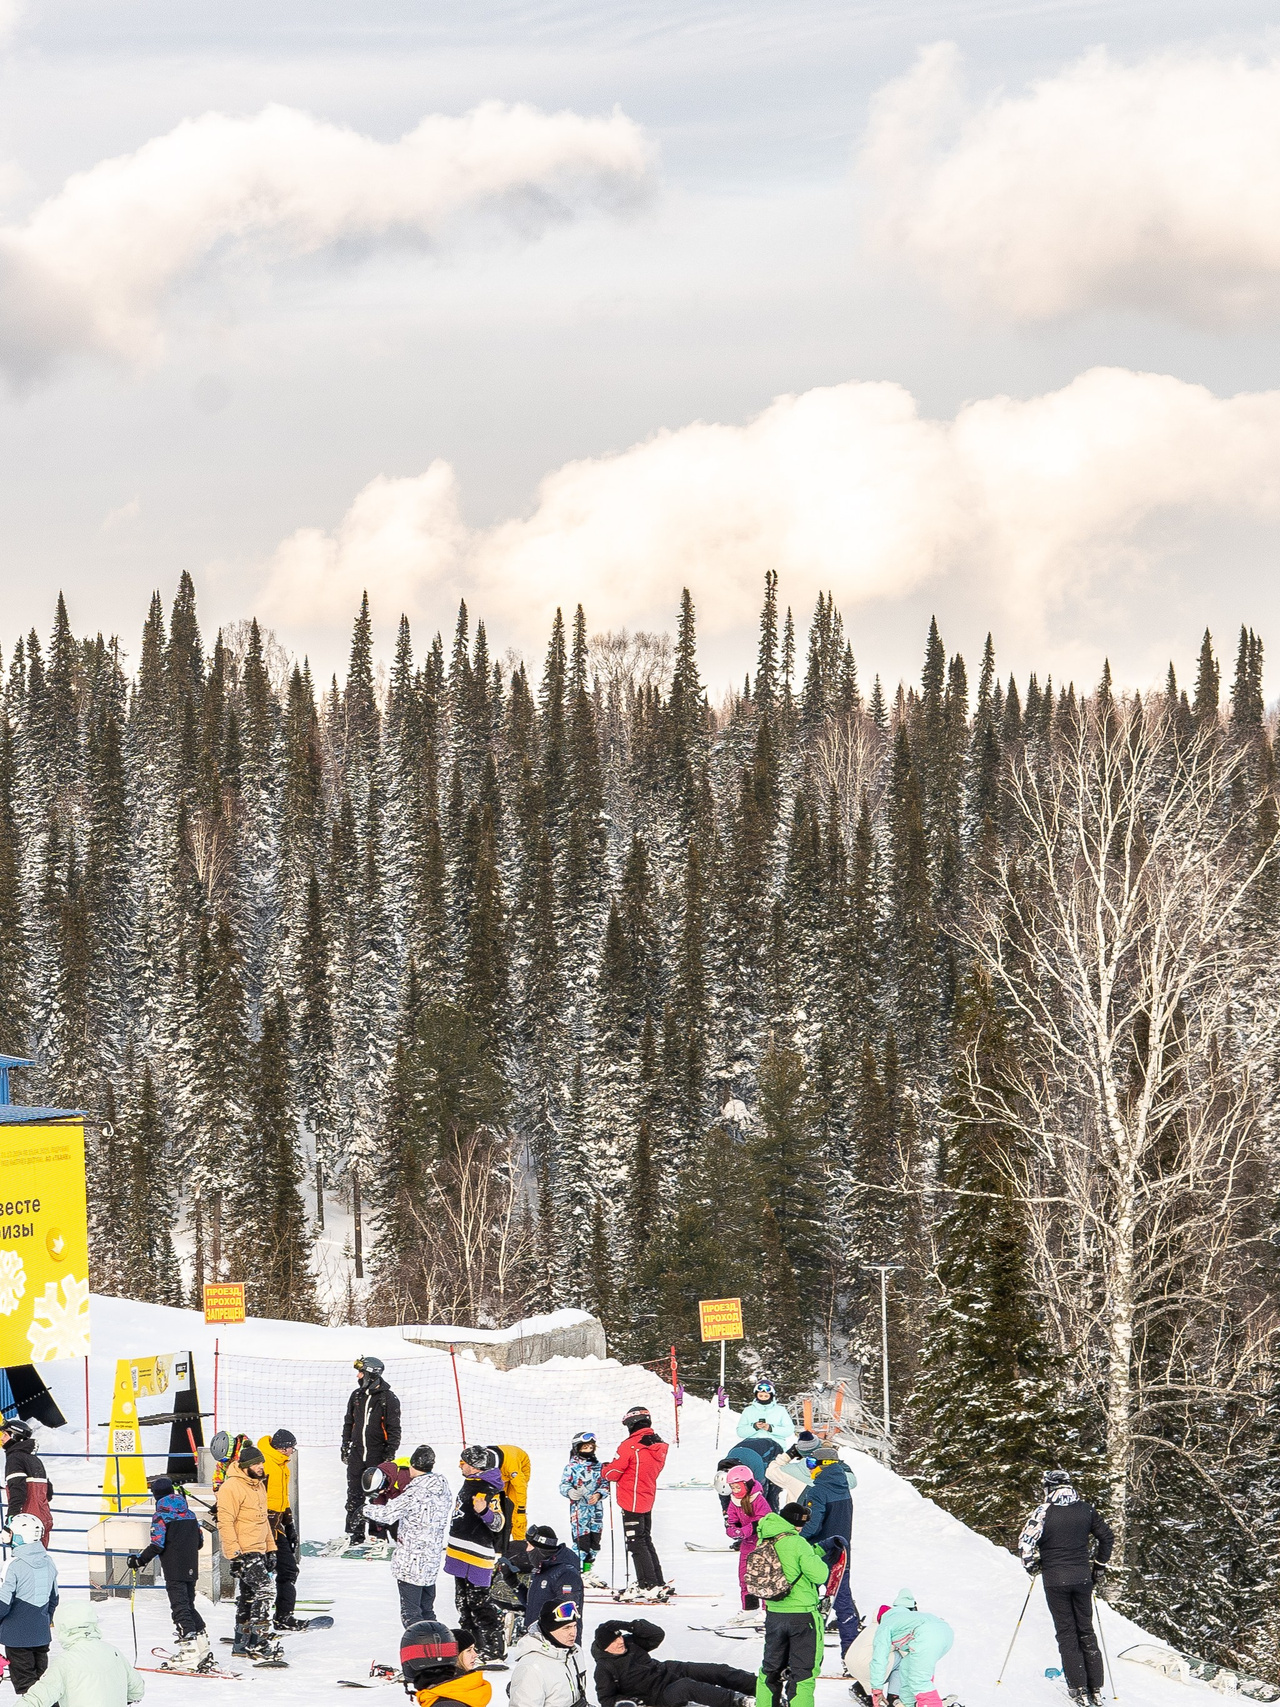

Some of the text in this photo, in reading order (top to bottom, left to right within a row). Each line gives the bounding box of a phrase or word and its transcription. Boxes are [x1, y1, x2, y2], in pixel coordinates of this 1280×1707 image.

[207, 1297, 242, 1306] ПРОХОД
[206, 1308, 244, 1321] ЗАПРЕЩЕН
[704, 1313, 739, 1323] ПРОХОД
[704, 1323, 741, 1337] ЗАПРЕЩЕН
